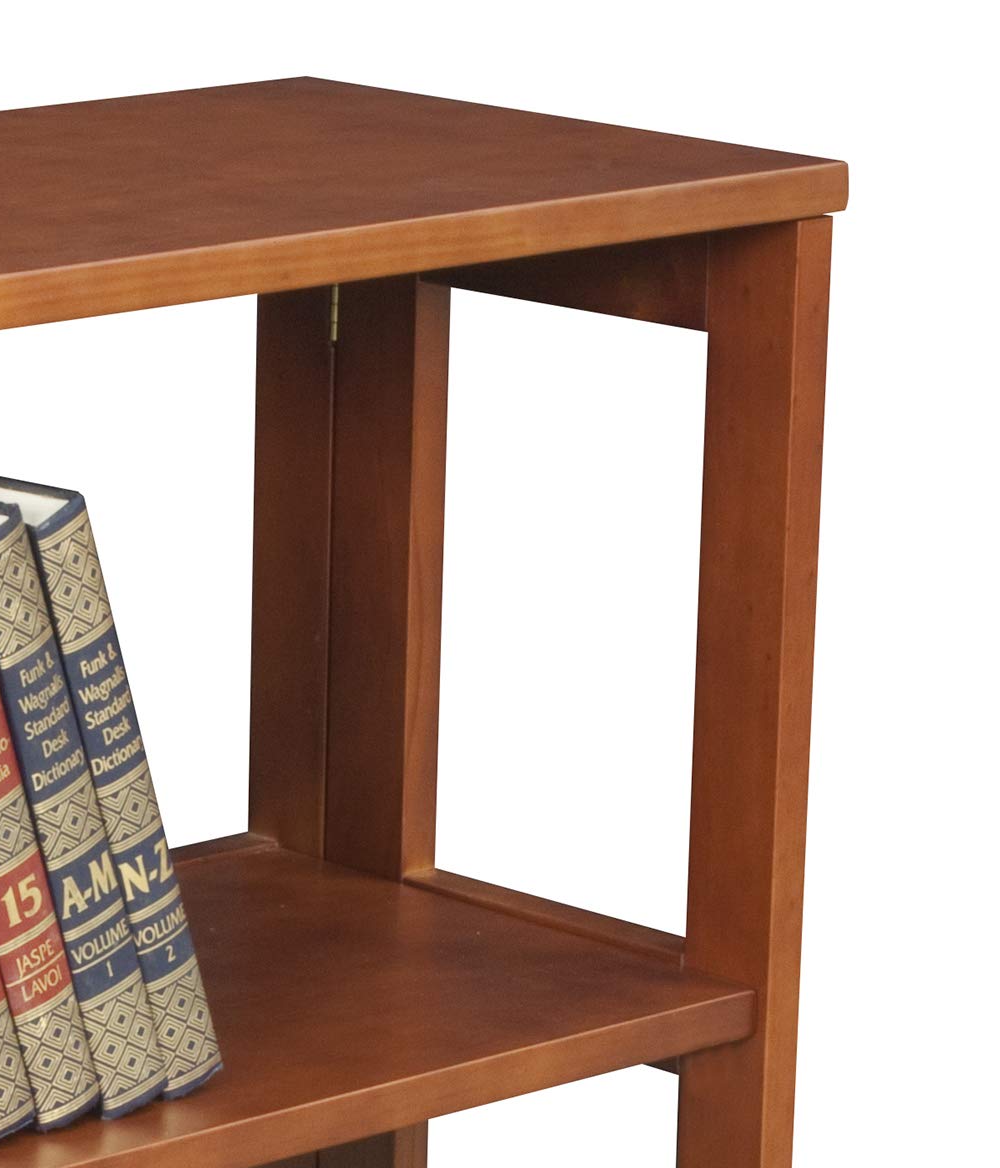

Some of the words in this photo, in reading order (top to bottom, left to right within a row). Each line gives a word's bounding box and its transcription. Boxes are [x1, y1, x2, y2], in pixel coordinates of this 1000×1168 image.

[20, 658, 46, 687] Funk
[45, 651, 55, 669] &
[80, 650, 108, 679] Funk
[107, 642, 117, 660] &
[18, 673, 64, 714] Wagnalls
[78, 665, 125, 704] Wagnalls
[24, 696, 70, 741] Standard
[102, 715, 131, 746] Desk
[41, 729, 70, 758] Desk
[91, 735, 144, 776] Dictionar
[31, 747, 85, 791] Dictionary
[62, 850, 118, 920] A-M
[118, 837, 174, 901] N-Z
[0, 873, 42, 928] 15
[70, 918, 129, 965] VOLUME
[133, 903, 186, 947] VOLUME
[16, 938, 54, 979] JASPE
[106, 960, 114, 977] 1
[165, 945, 176, 963] 2
[21, 964, 62, 1002] LAVOI
